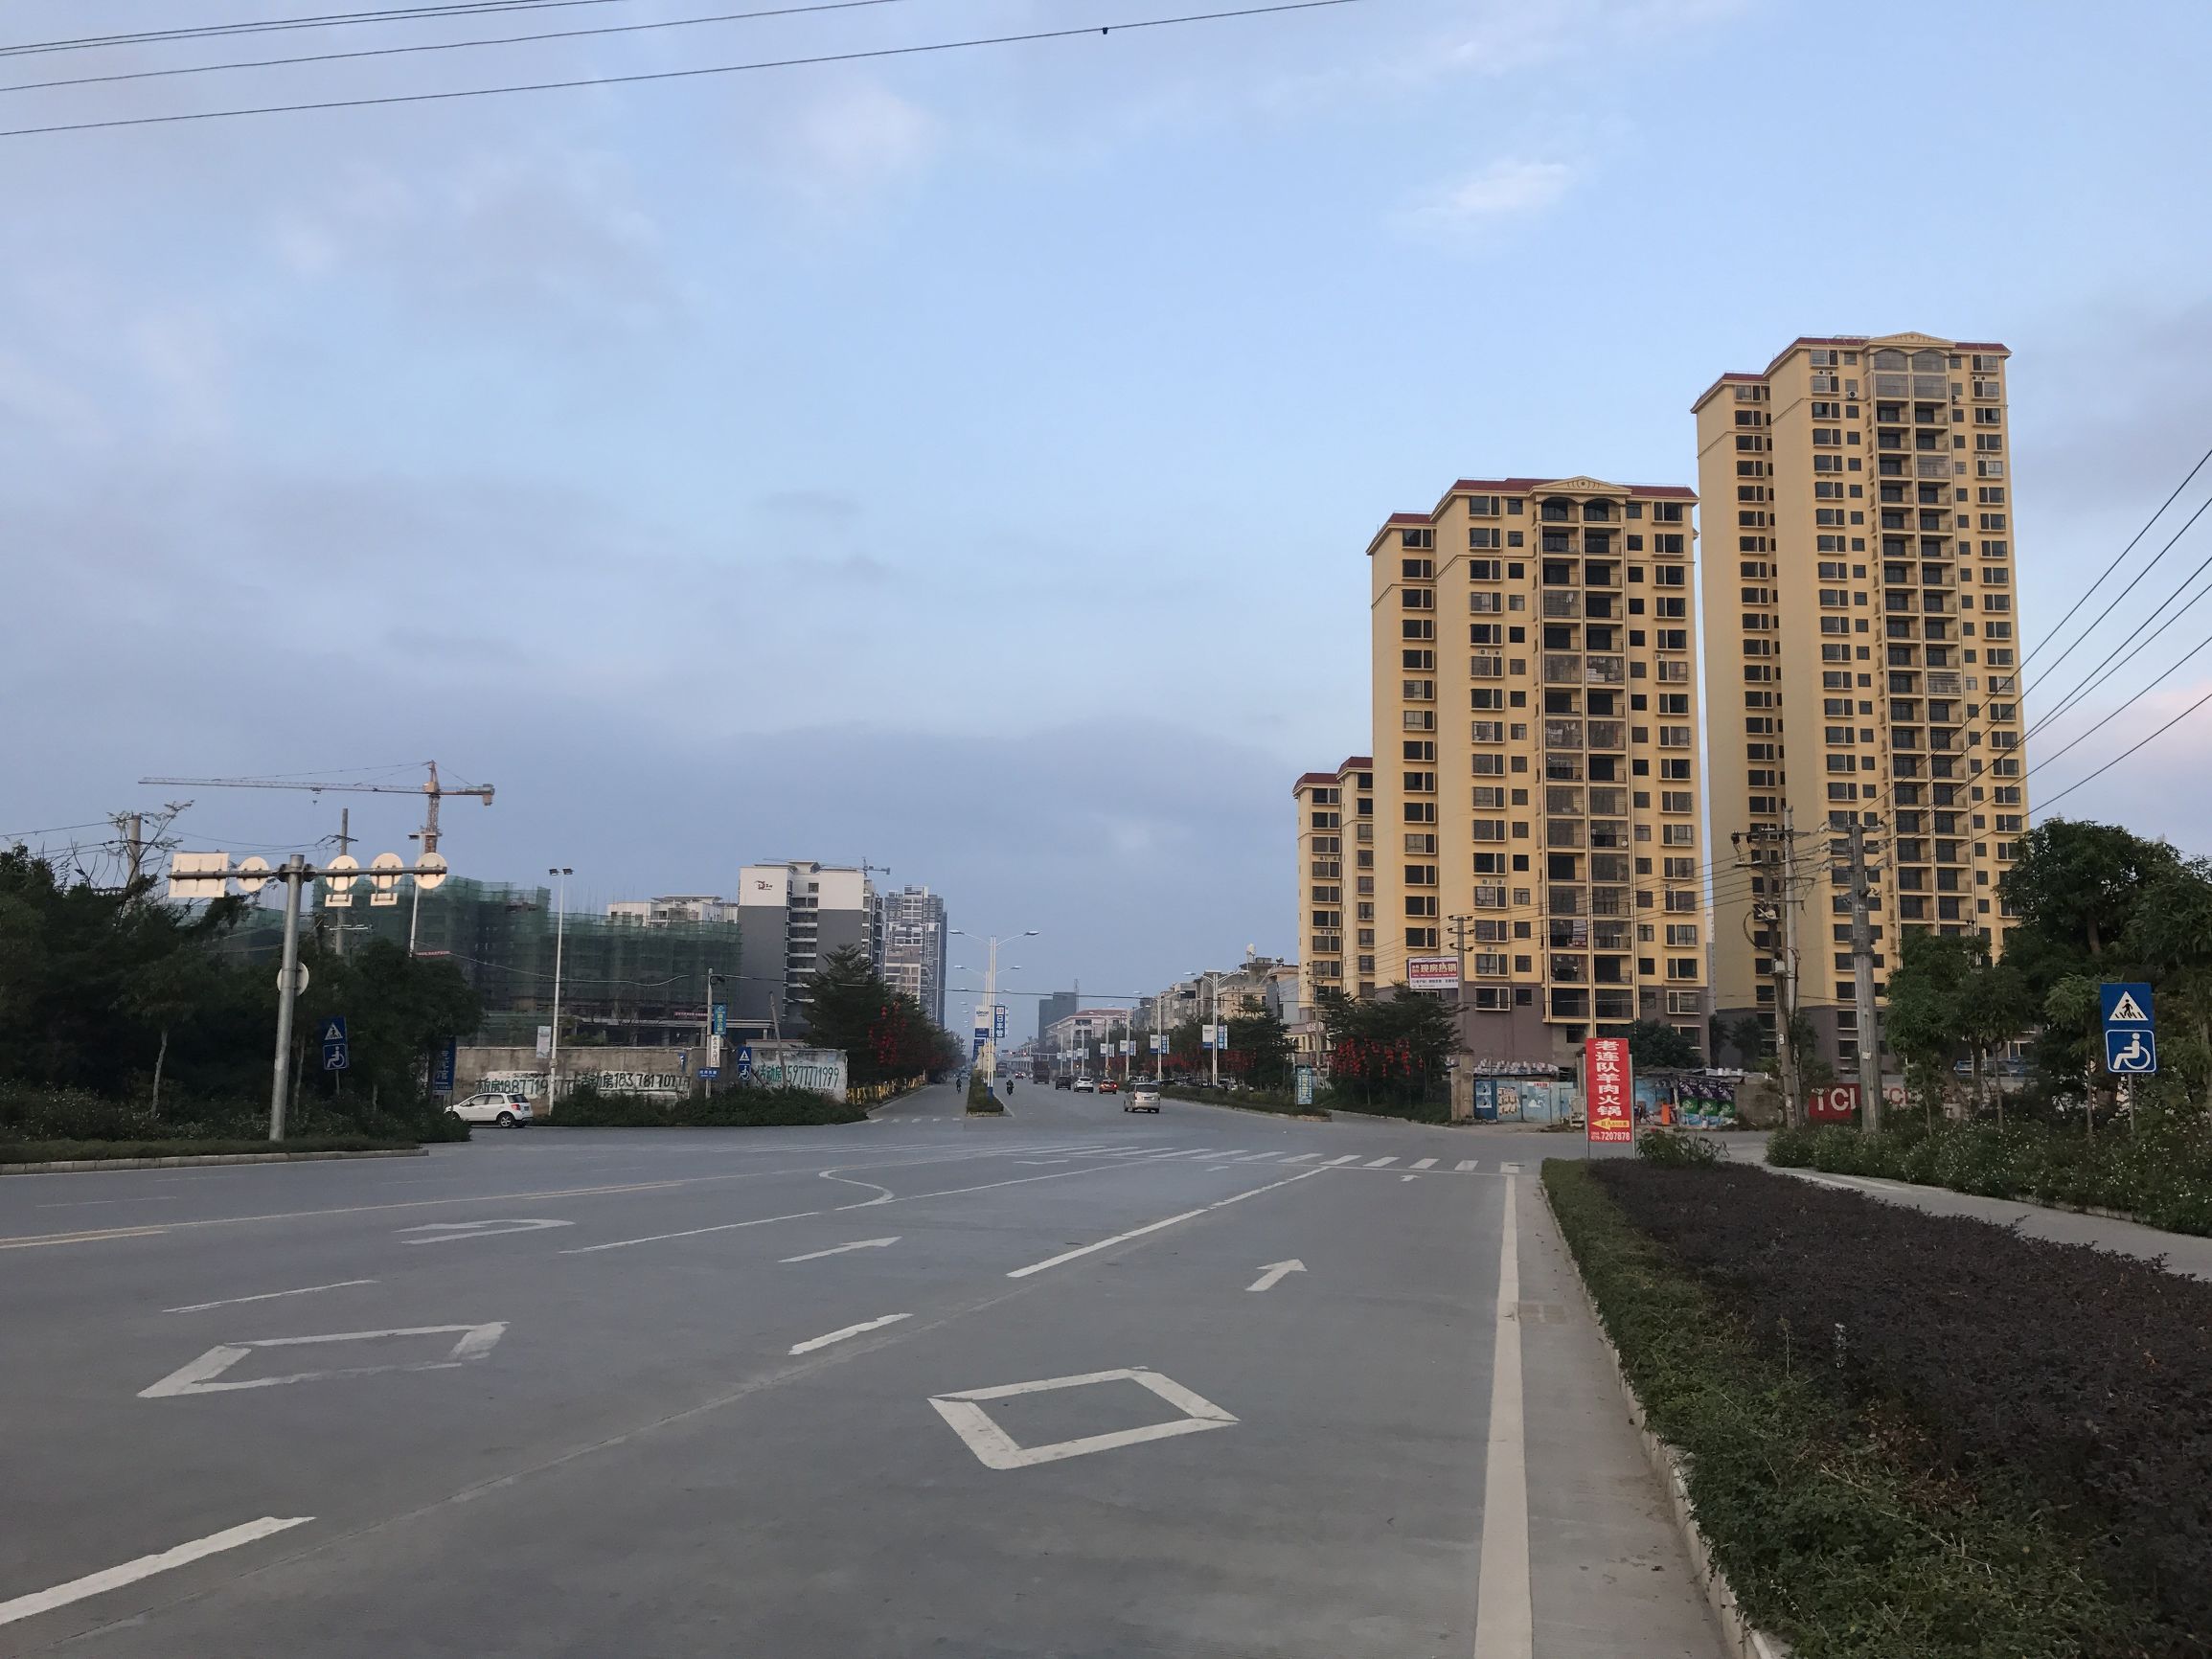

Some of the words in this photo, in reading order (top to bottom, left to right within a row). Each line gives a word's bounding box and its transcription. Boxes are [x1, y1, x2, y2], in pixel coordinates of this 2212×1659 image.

[1594, 1040, 1623, 1117] 老连队羊肉火锅
[1601, 1131, 1630, 1141] 7207878
